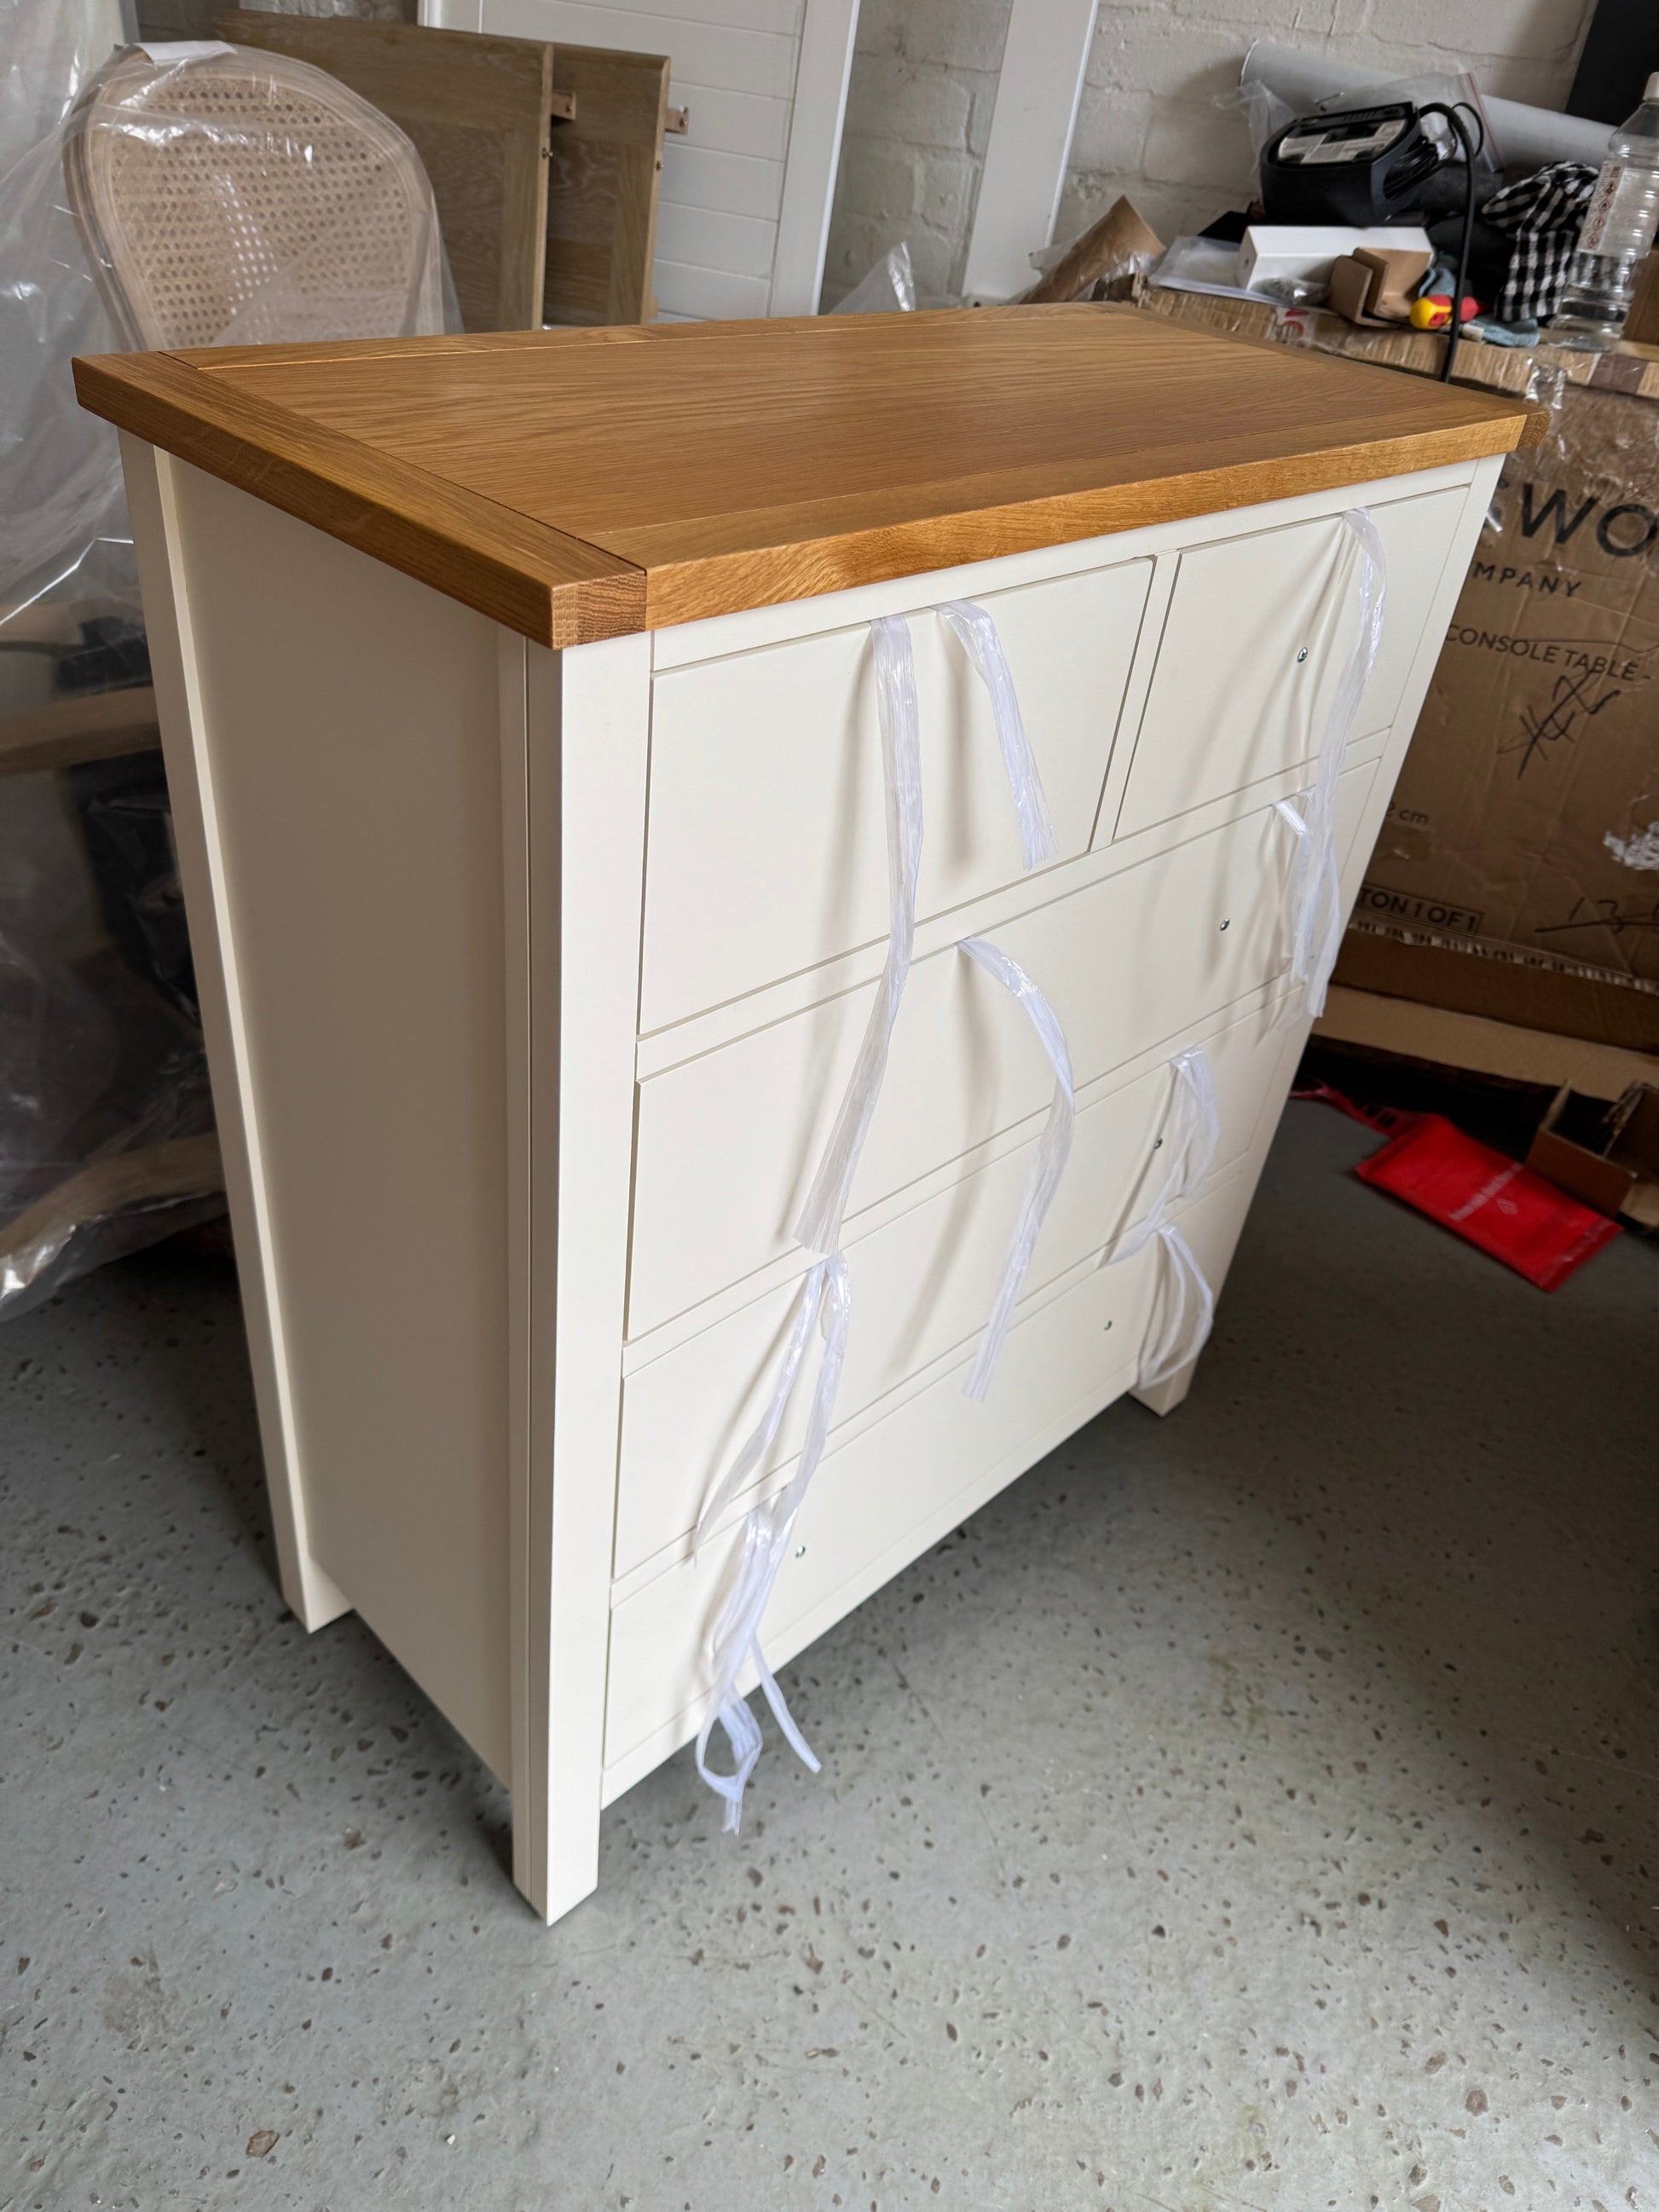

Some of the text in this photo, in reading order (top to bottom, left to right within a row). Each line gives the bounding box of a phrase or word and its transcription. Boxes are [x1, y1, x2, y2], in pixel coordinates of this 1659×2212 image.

[1472, 562, 1581, 597] MPANY
[1446, 624, 1560, 663] CONSOLE
[1564, 650, 1639, 681] TABLE
[1399, 810, 1429, 825] cm
[1361, 888, 1477, 931] TON 1 OF 1
